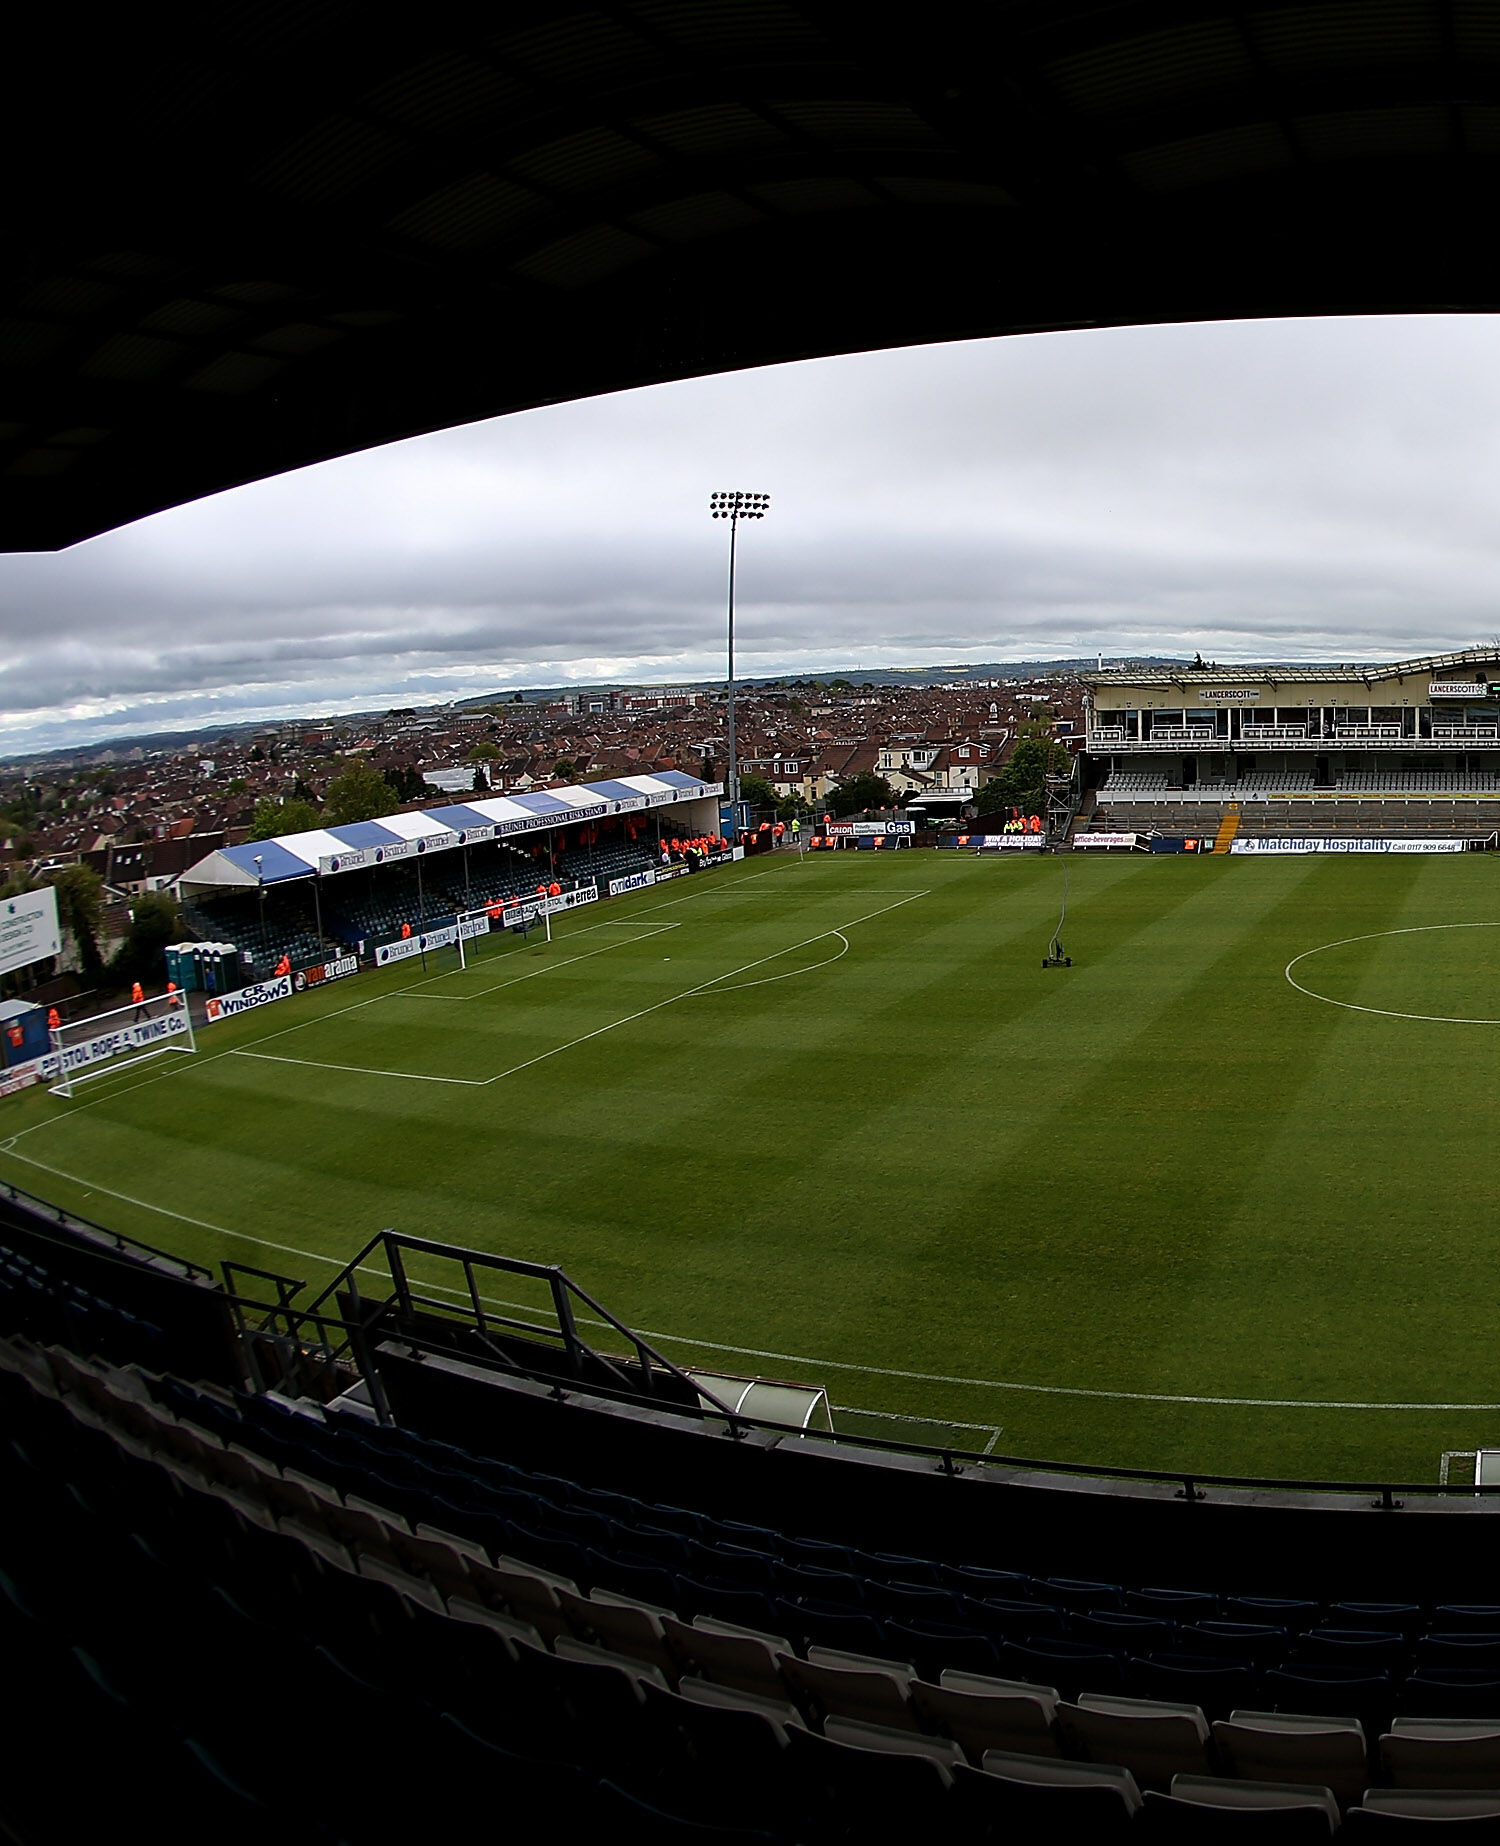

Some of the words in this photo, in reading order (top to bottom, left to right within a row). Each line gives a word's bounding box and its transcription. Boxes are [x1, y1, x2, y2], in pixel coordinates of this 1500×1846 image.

[1205, 690, 1250, 699] LANCERSCOTT
[1430, 686, 1476, 694] LANCERSCOTT
[500, 820, 525, 834] BRUNEL
[829, 826, 852, 835] CALOR
[886, 822, 911, 833] Gas
[1257, 839, 1320, 852] Matchday
[1322, 839, 1392, 852] Hospitality
[1392, 843, 1405, 851] Call
[575, 887, 597, 904] errea
[462, 918, 486, 936] Brunel
[427, 929, 450, 946] Brunel
[389, 940, 413, 958] Brunel
[305, 954, 358, 984] vanarama
[220, 978, 289, 1015] WINDOWS
[242, 984, 265, 998] CR
[92, 1035, 119, 1058] ROPE
[134, 1020, 167, 1043] TWINE
[168, 1017, 185, 1031] Co.
